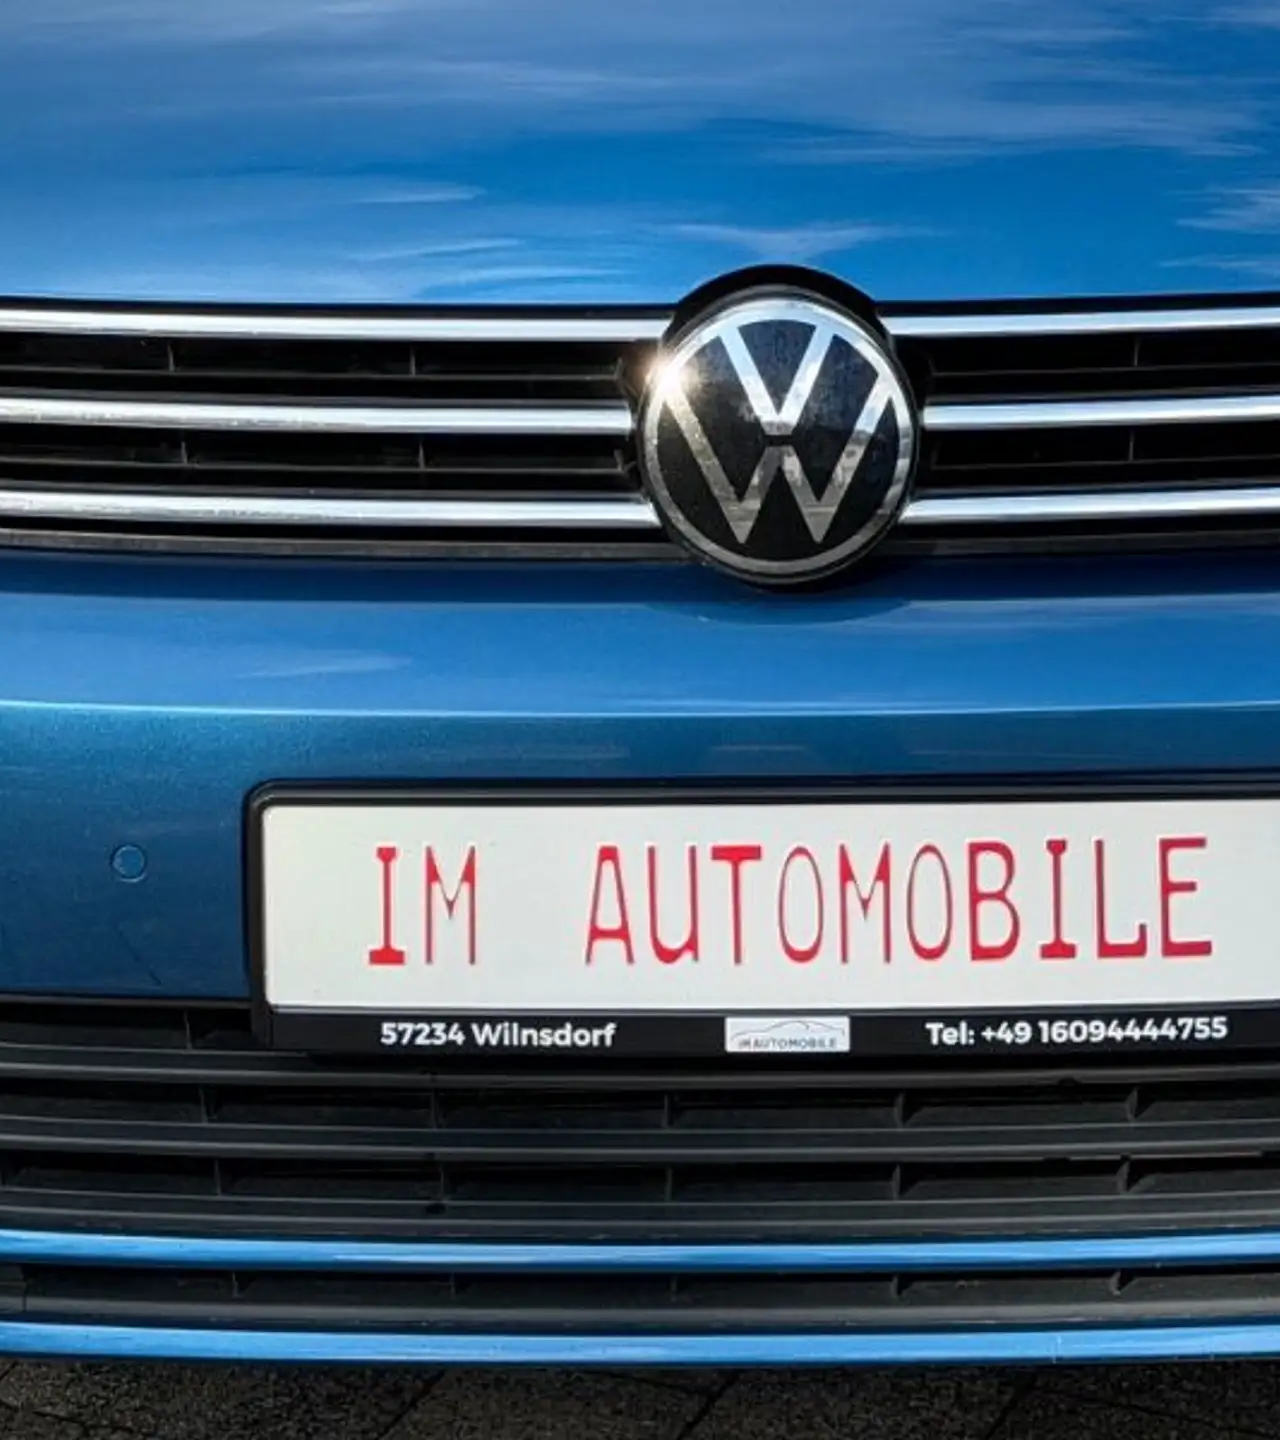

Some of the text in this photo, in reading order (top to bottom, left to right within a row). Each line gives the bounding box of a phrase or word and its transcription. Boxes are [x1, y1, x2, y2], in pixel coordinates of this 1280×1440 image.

[368, 845, 477, 966] IM
[585, 836, 1213, 966] AUTOMOBILE
[380, 1021, 617, 1047] 57234 Wilnsdorf
[925, 1016, 1228, 1046] Tel: +49 16094444755
